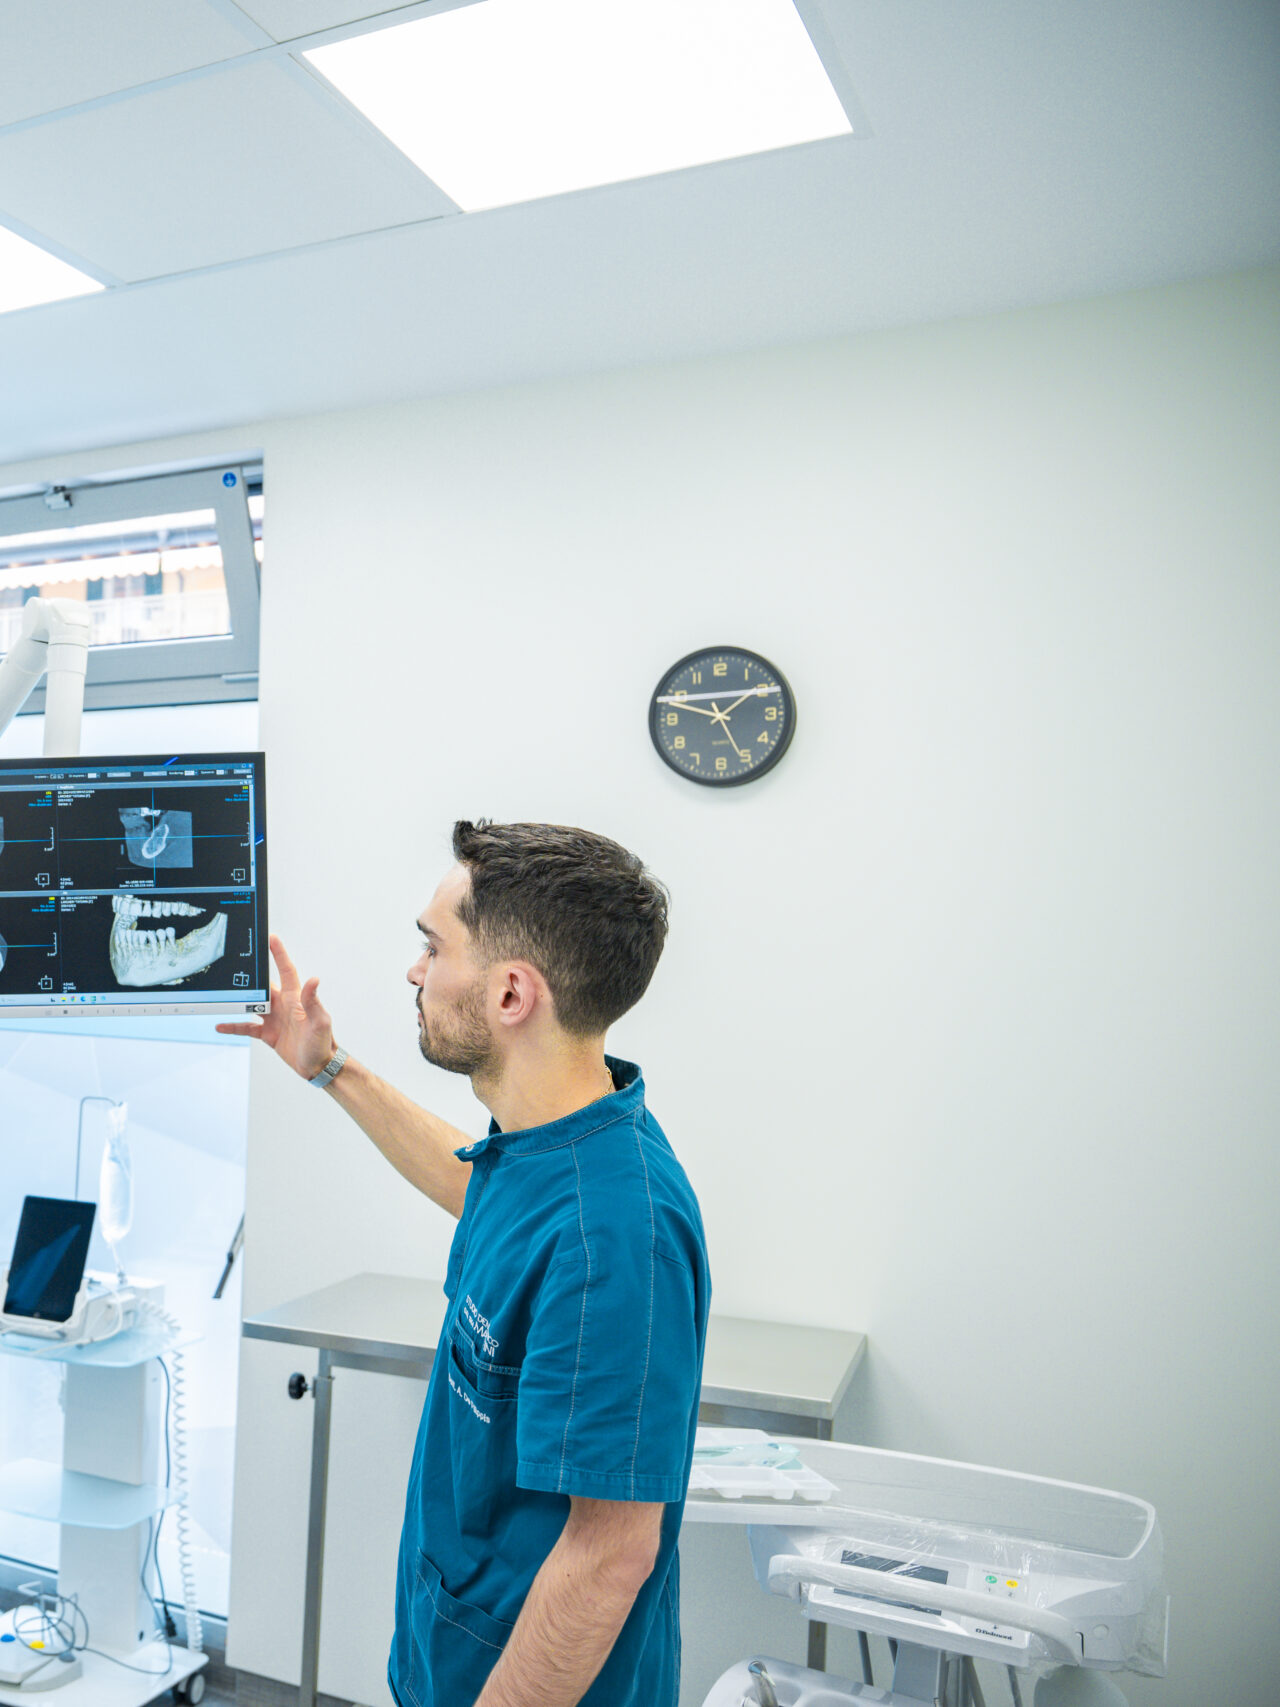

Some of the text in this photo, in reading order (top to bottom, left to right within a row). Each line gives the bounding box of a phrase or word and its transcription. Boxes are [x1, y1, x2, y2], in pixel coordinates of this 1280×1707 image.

[713, 662, 728, 676] 12
[744, 668, 749, 680] 1
[692, 672, 702, 684] 11
[757, 684, 768, 697] 2
[667, 712, 678, 726] 9
[765, 707, 777, 721] 3
[674, 736, 685, 749] 8
[757, 731, 768, 744] 4
[689, 753, 700, 766] 7
[740, 749, 751, 763] 5
[716, 757, 727, 771] 6
